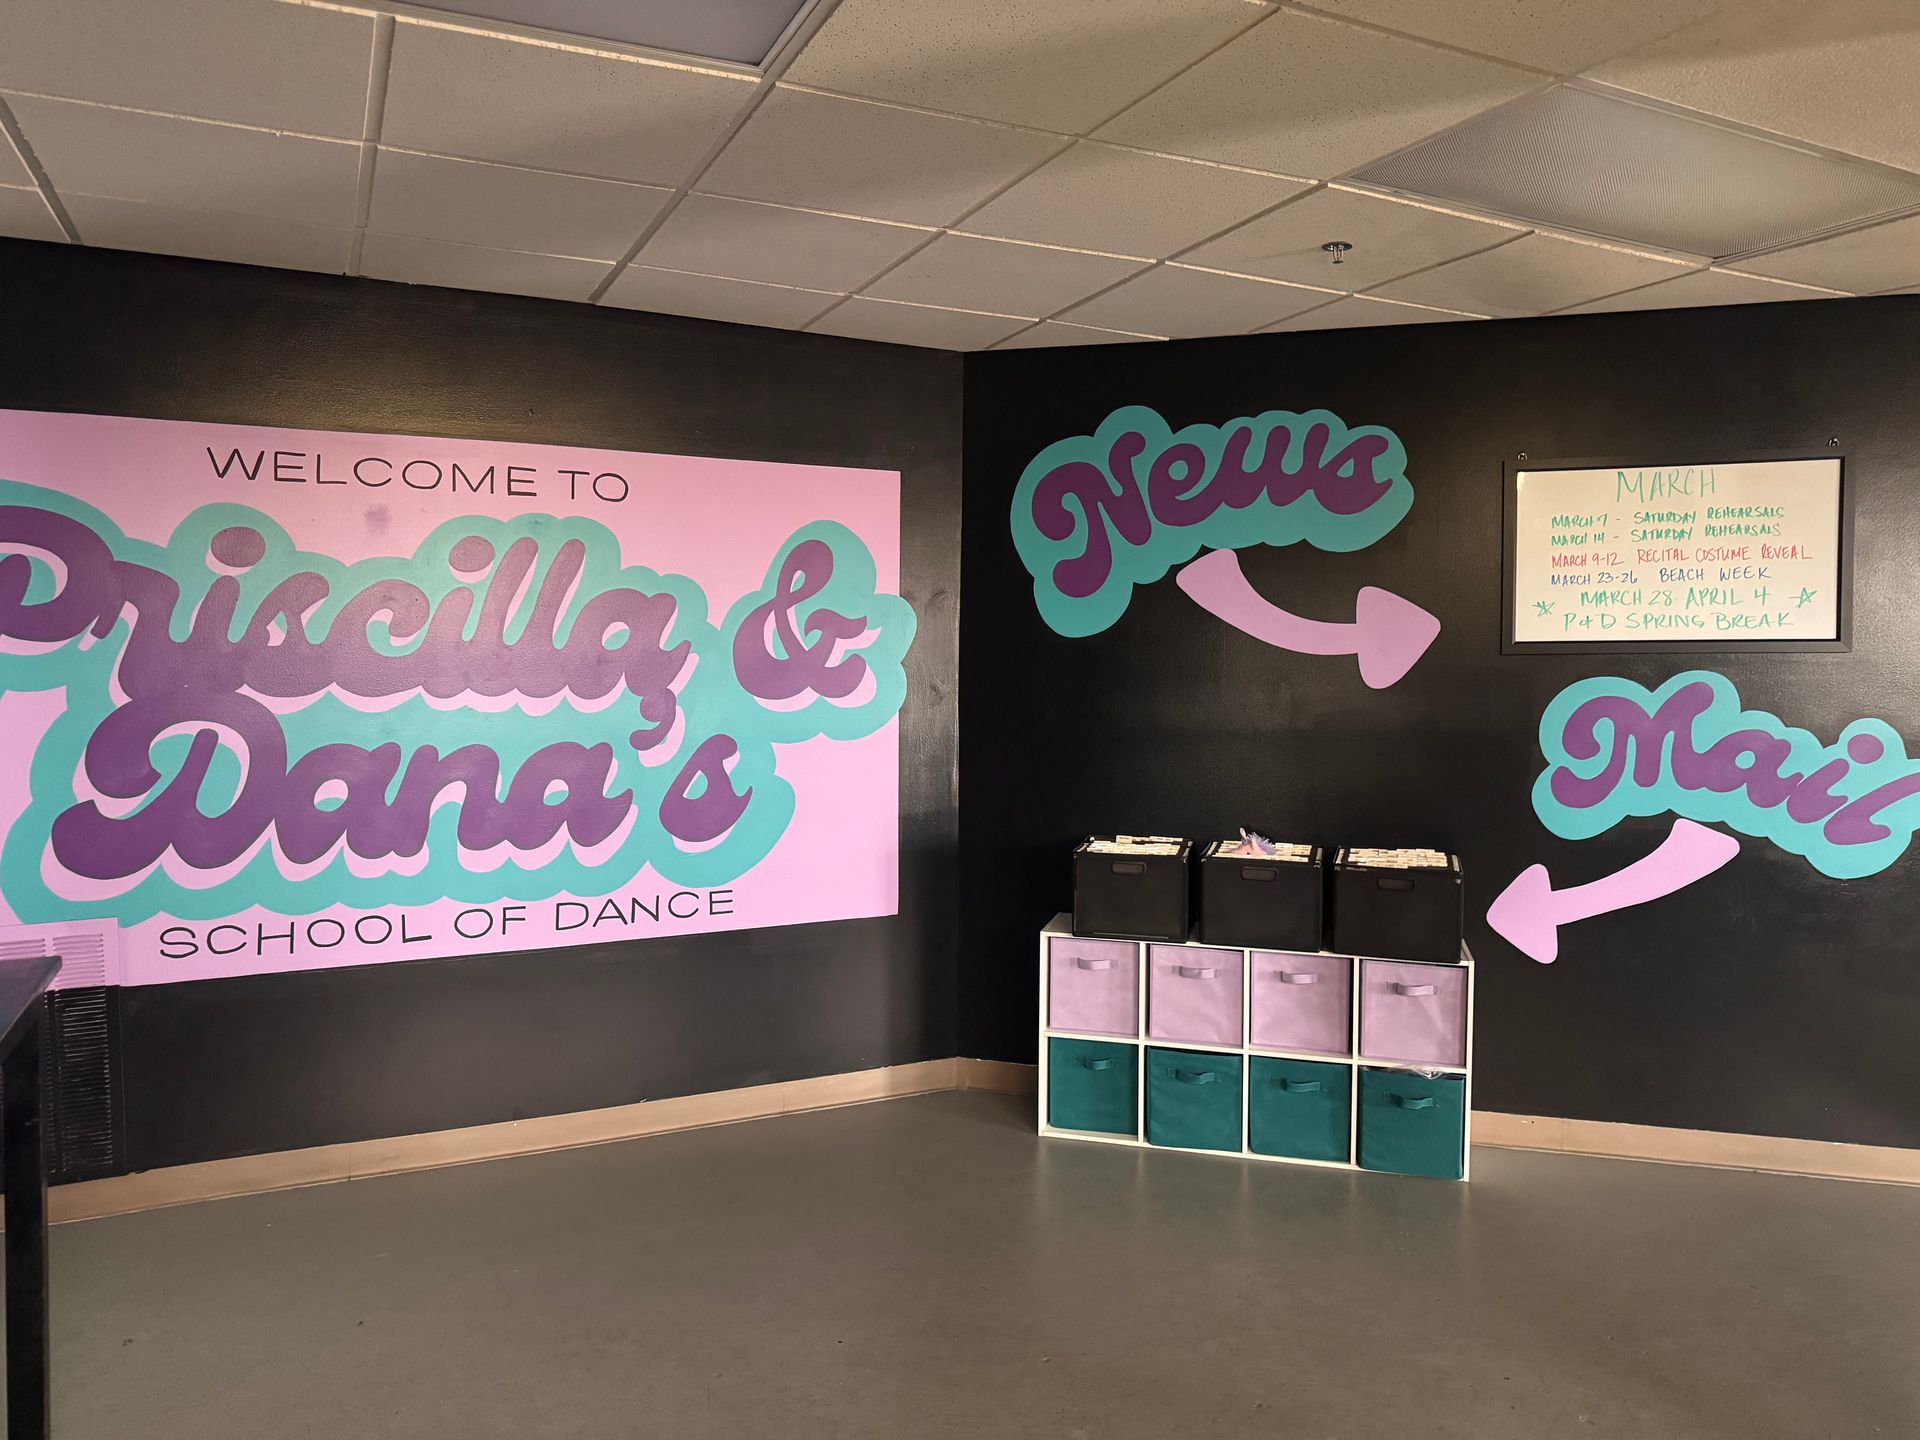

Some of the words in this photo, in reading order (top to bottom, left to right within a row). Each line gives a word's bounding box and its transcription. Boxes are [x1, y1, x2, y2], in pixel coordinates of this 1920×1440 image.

[205, 446, 538, 499] WELCOME
[558, 469, 631, 503] TO
[1616, 467, 1716, 503] MARCH
[1031, 422, 1394, 599] News
[1551, 514, 1593, 528] MARCH
[1596, 513, 1608, 528] 7
[1633, 510, 1697, 524] SATURDAY
[1706, 505, 1785, 520] REHEARSALS
[1551, 532, 1588, 547] MARCH
[1593, 532, 1606, 544] 14
[1631, 526, 1693, 542] SATURDAY
[1704, 522, 1782, 538] REHEARSALS
[1551, 553, 1587, 569] MARCH
[1591, 552, 1626, 567] 9-12
[1637, 546, 1690, 564] RECITAL
[1695, 545, 1752, 563] COSTUME
[1761, 543, 1814, 560] REVEAL
[1550, 573, 1592, 587] MARCH
[1596, 570, 1638, 584] 23-26
[1659, 567, 1705, 583] BEACH
[1719, 565, 1773, 581] WEEK
[1580, 588, 1642, 608] MARCH
[1685, 586, 1744, 609] APRIL
[1754, 585, 1771, 607] 4
[733, 540, 867, 700] &
[1626, 612, 1705, 630] SPRING
[1711, 611, 1795, 631] BREAK
[51, 688, 752, 880] Dana's
[159, 913, 433, 960] SCHOOL
[453, 904, 528, 941] OF
[554, 888, 735, 933] DANCE
